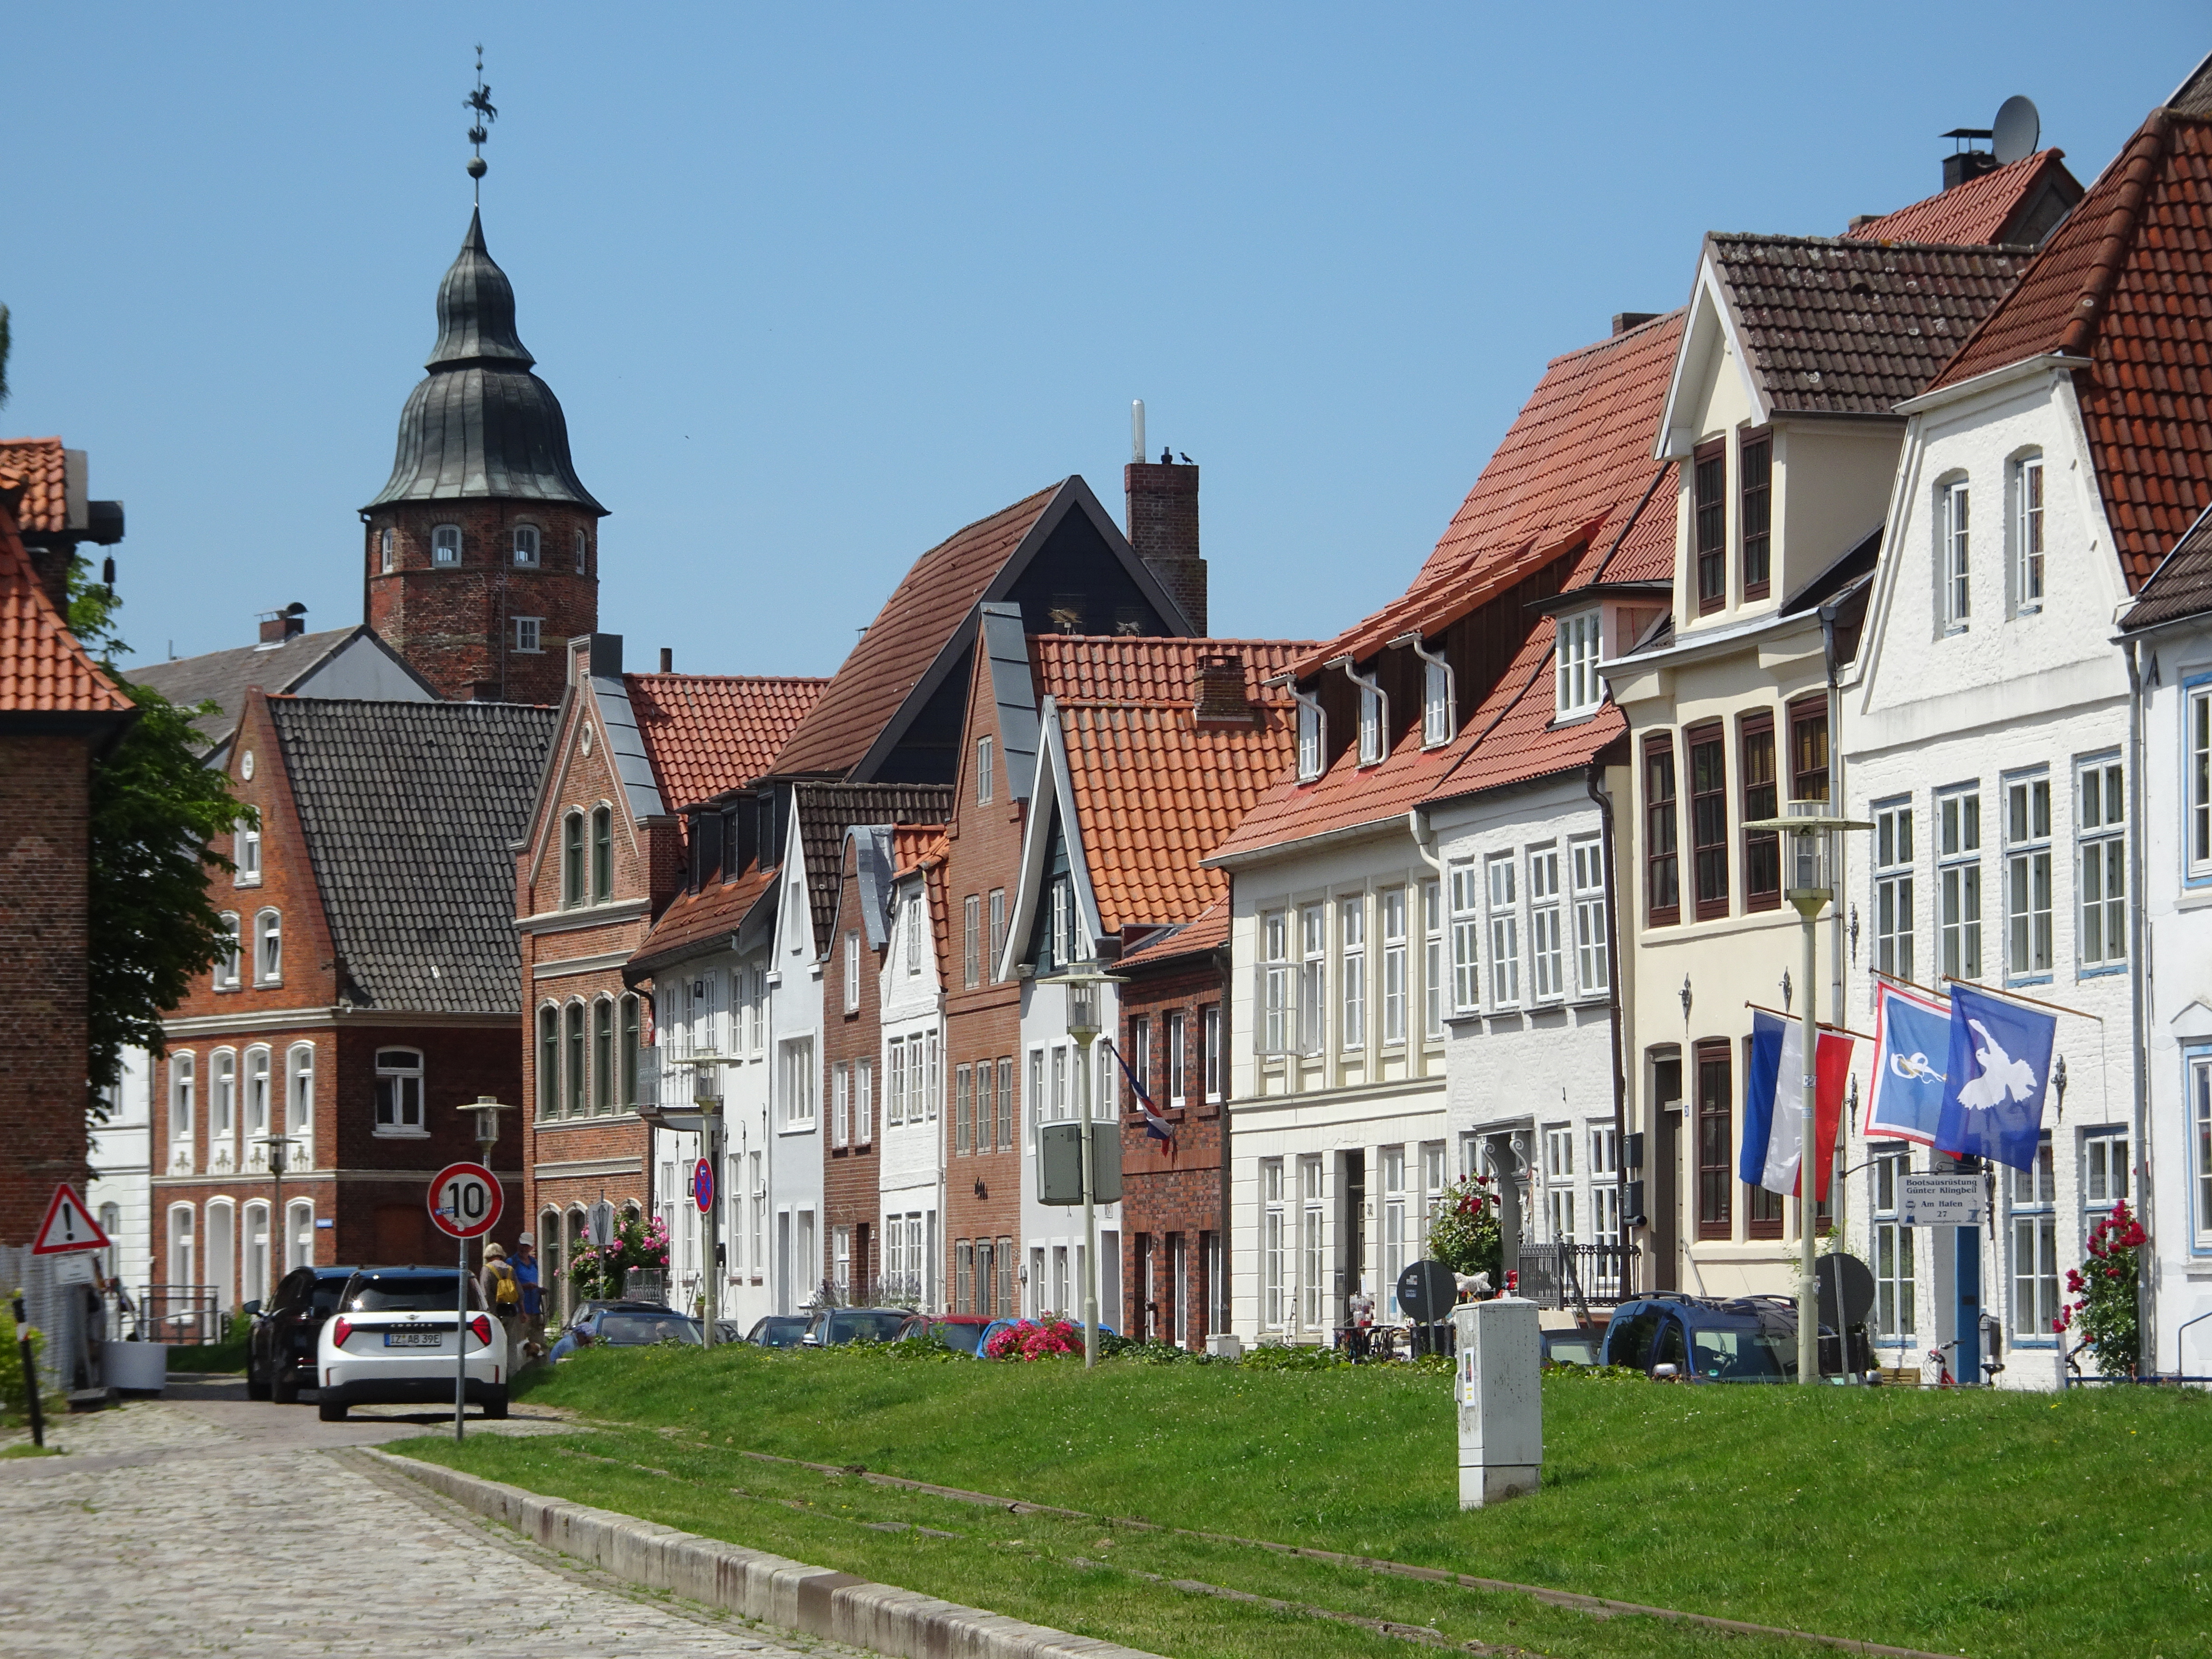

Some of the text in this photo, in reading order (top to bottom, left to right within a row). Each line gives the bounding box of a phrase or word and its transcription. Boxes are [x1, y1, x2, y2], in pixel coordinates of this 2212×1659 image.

[1906, 1178, 1977, 1186] Bootsausrüstung
[1940, 1187, 1977, 1195] Klingbeil
[449, 1182, 484, 1218] 10
[391, 1335, 440, 1344] IZ AB 39E
